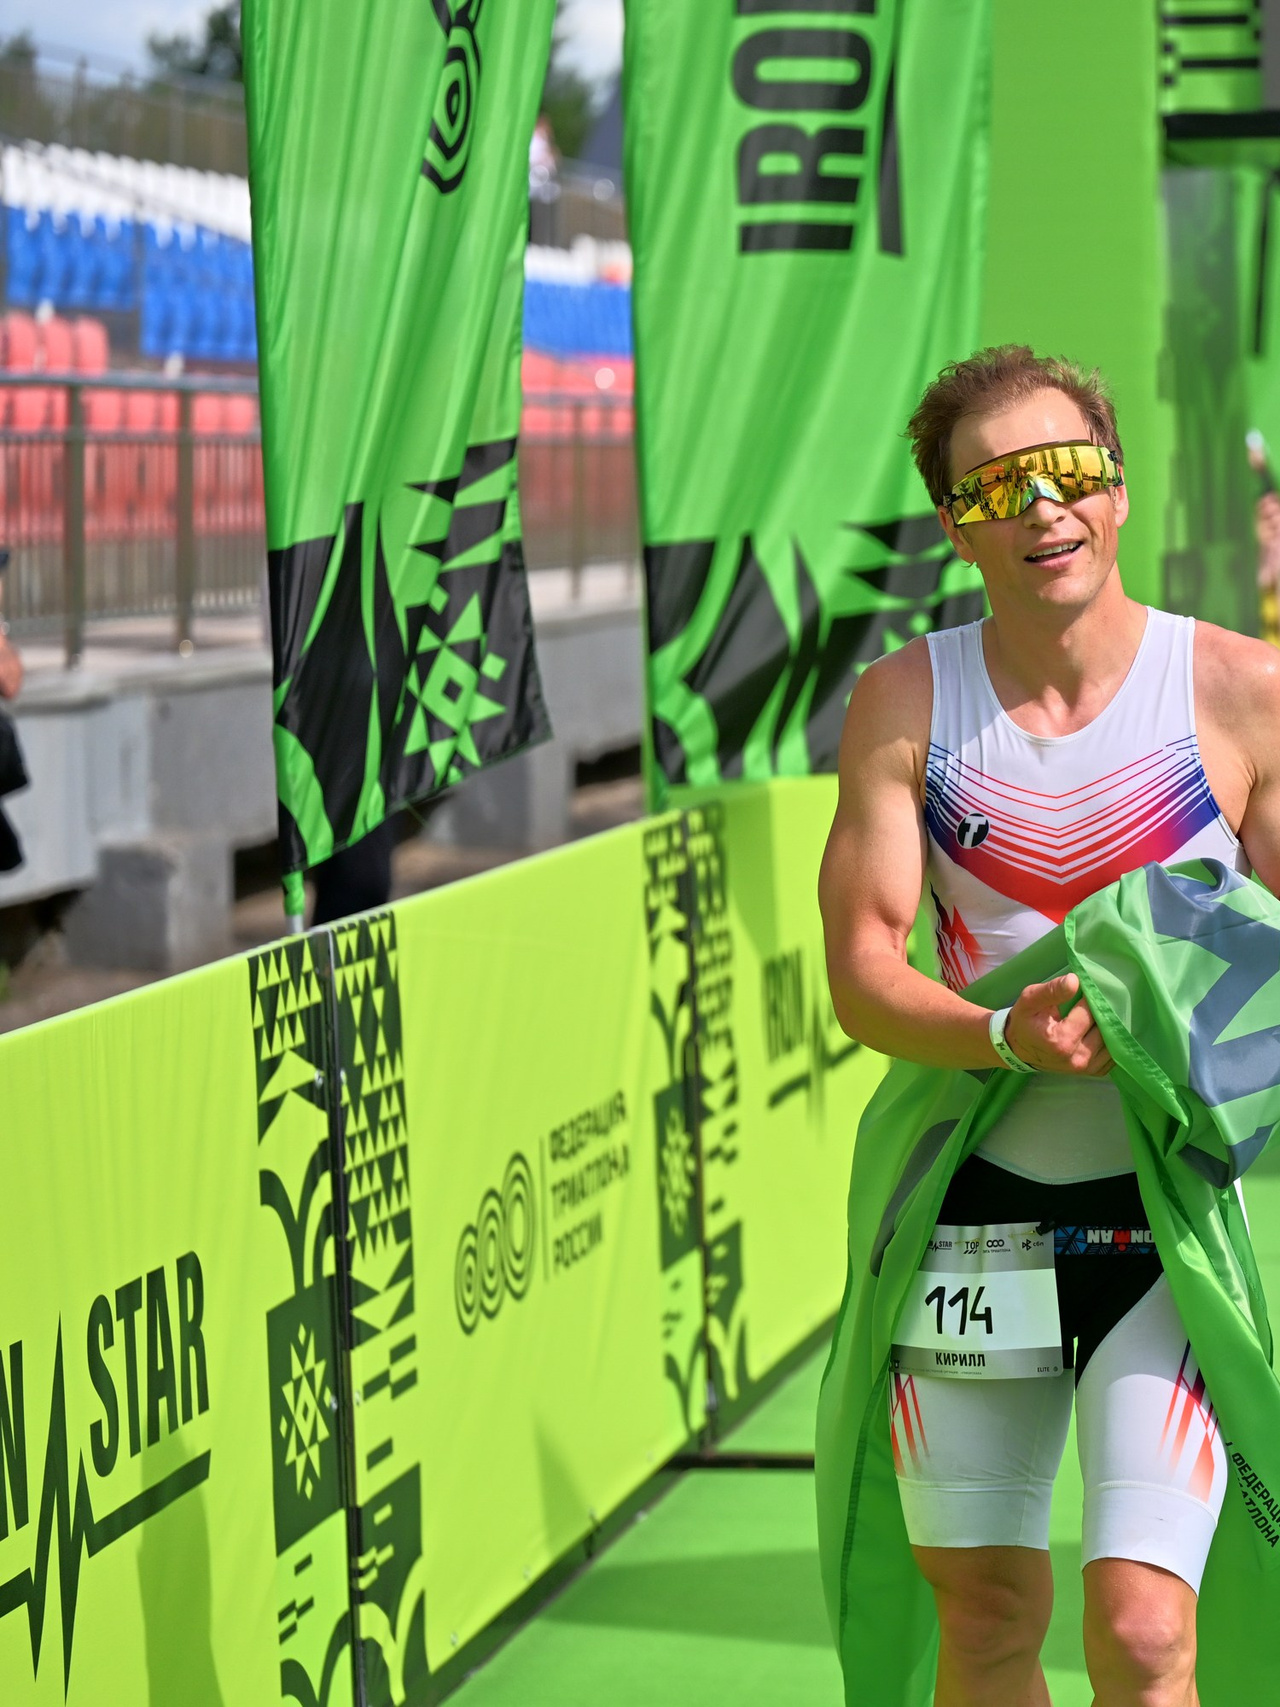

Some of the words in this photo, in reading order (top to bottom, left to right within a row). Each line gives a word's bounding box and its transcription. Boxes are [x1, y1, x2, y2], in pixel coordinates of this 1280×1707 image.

[964, 1241, 980, 1251] TOP
[925, 1286, 994, 1336] 114
[87, 1249, 210, 1478] STAR
[935, 1351, 986, 1368] КИРИЛЛ
